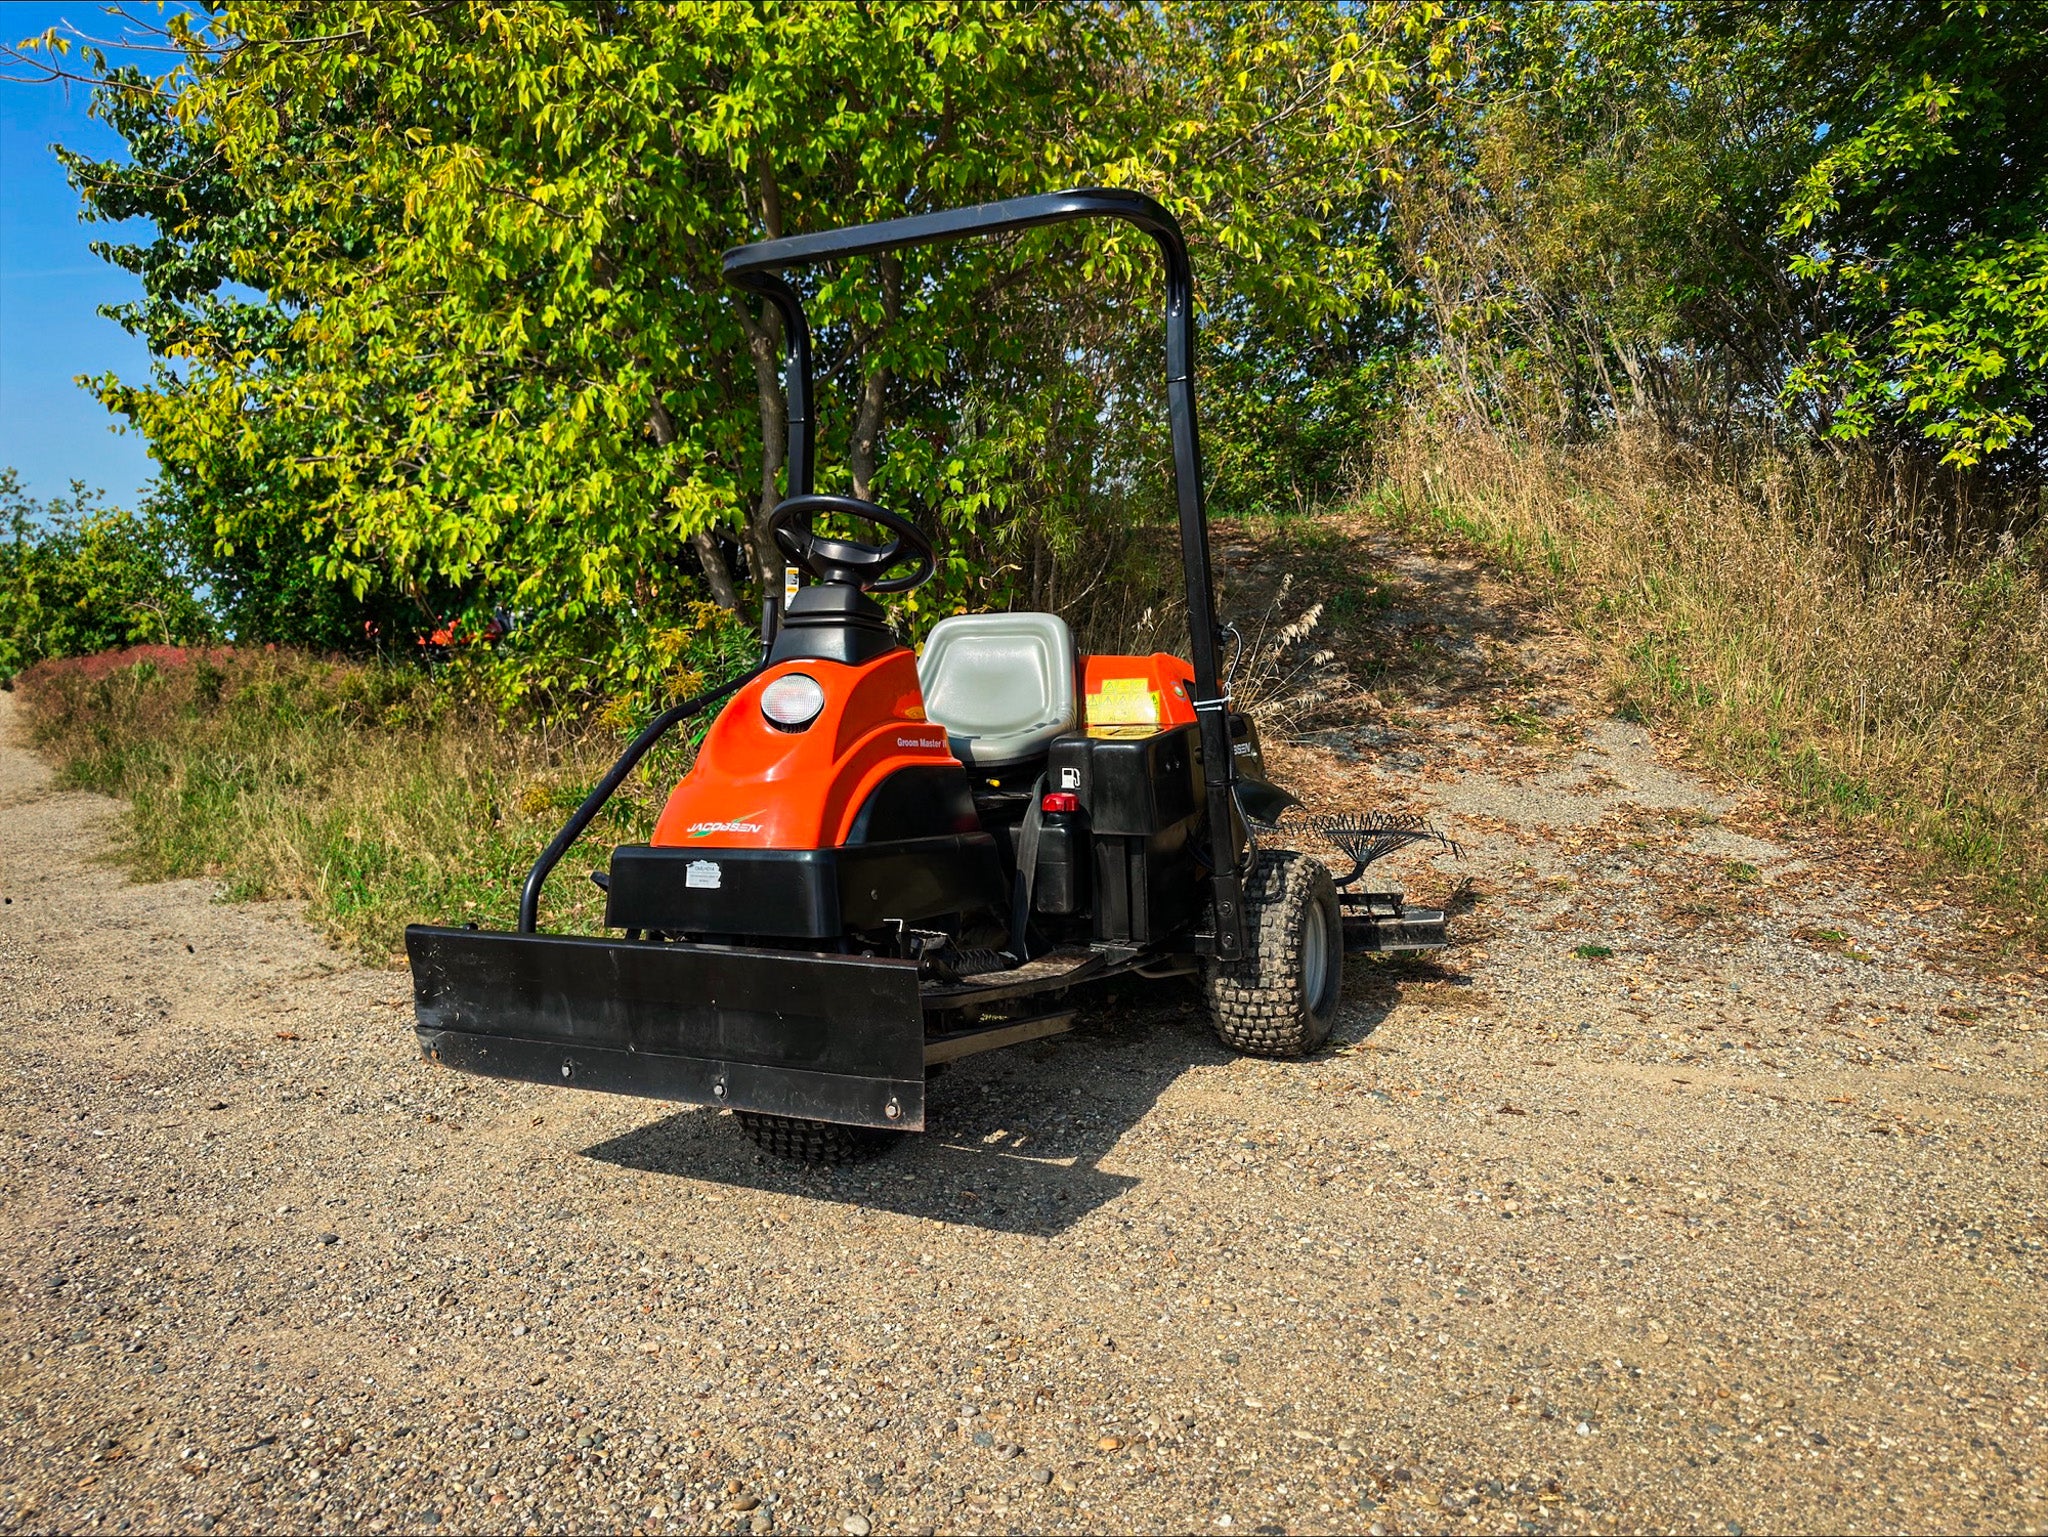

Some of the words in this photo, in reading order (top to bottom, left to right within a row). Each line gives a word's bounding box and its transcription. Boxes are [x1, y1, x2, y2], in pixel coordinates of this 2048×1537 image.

[897, 737, 919, 747] Groom
[920, 738, 941, 748] Master
[687, 822, 763, 833] JACOBSEN
